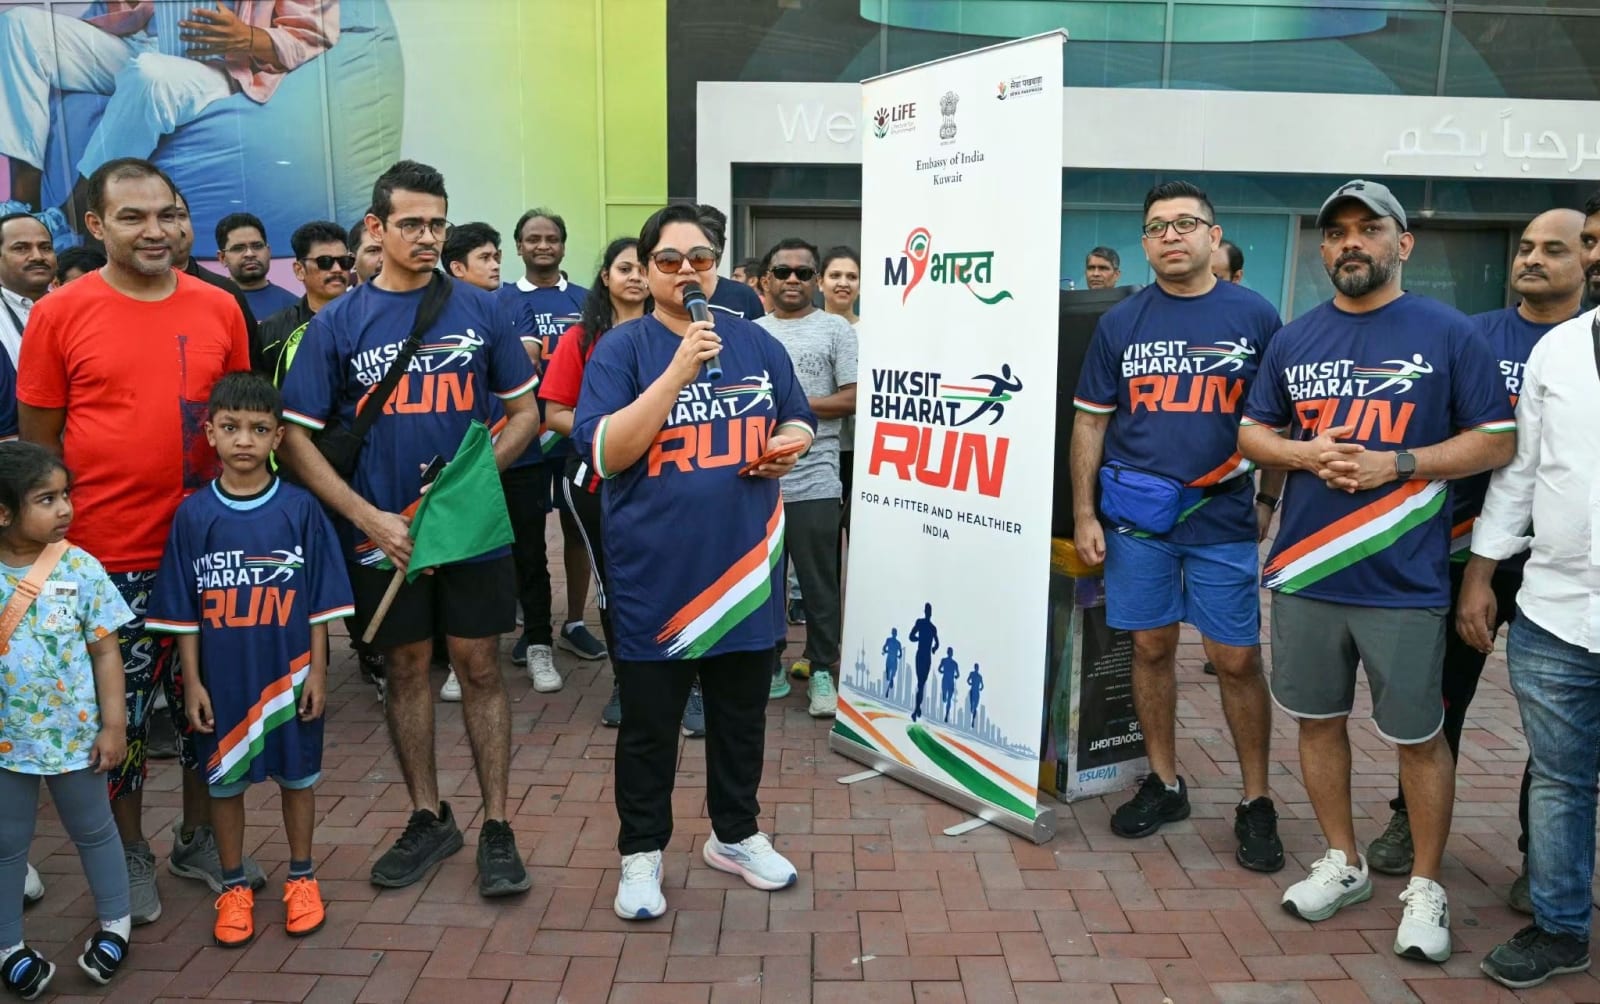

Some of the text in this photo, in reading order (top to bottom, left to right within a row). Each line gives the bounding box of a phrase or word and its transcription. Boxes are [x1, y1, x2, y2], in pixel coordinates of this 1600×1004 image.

[891, 102, 917, 122] LiFE
[1384, 114, 1488, 171] بكم
[916, 150, 985, 171] Embassy of India
[933, 171, 963, 186] Kuwait
[930, 251, 999, 288] भारत
[1123, 340, 1187, 361] VIKSIT
[1121, 356, 1206, 378] BHARAT
[1285, 359, 1354, 384] VIKSIT
[872, 369, 942, 398] VIKSIT
[1129, 374, 1245, 415] RUN
[1287, 378, 1370, 401] BHARAT
[870, 394, 961, 427] BHARAT
[648, 416, 777, 477] RUN
[868, 421, 1010, 498] RUN
[861, 491, 1023, 535] FOR A FITTER AND HEALTHIER
[922, 523, 950, 540] INDIA
[193, 550, 245, 576] VIKSIT
[202, 586, 297, 629] RUN
[1079, 765, 1118, 783] Wansa
